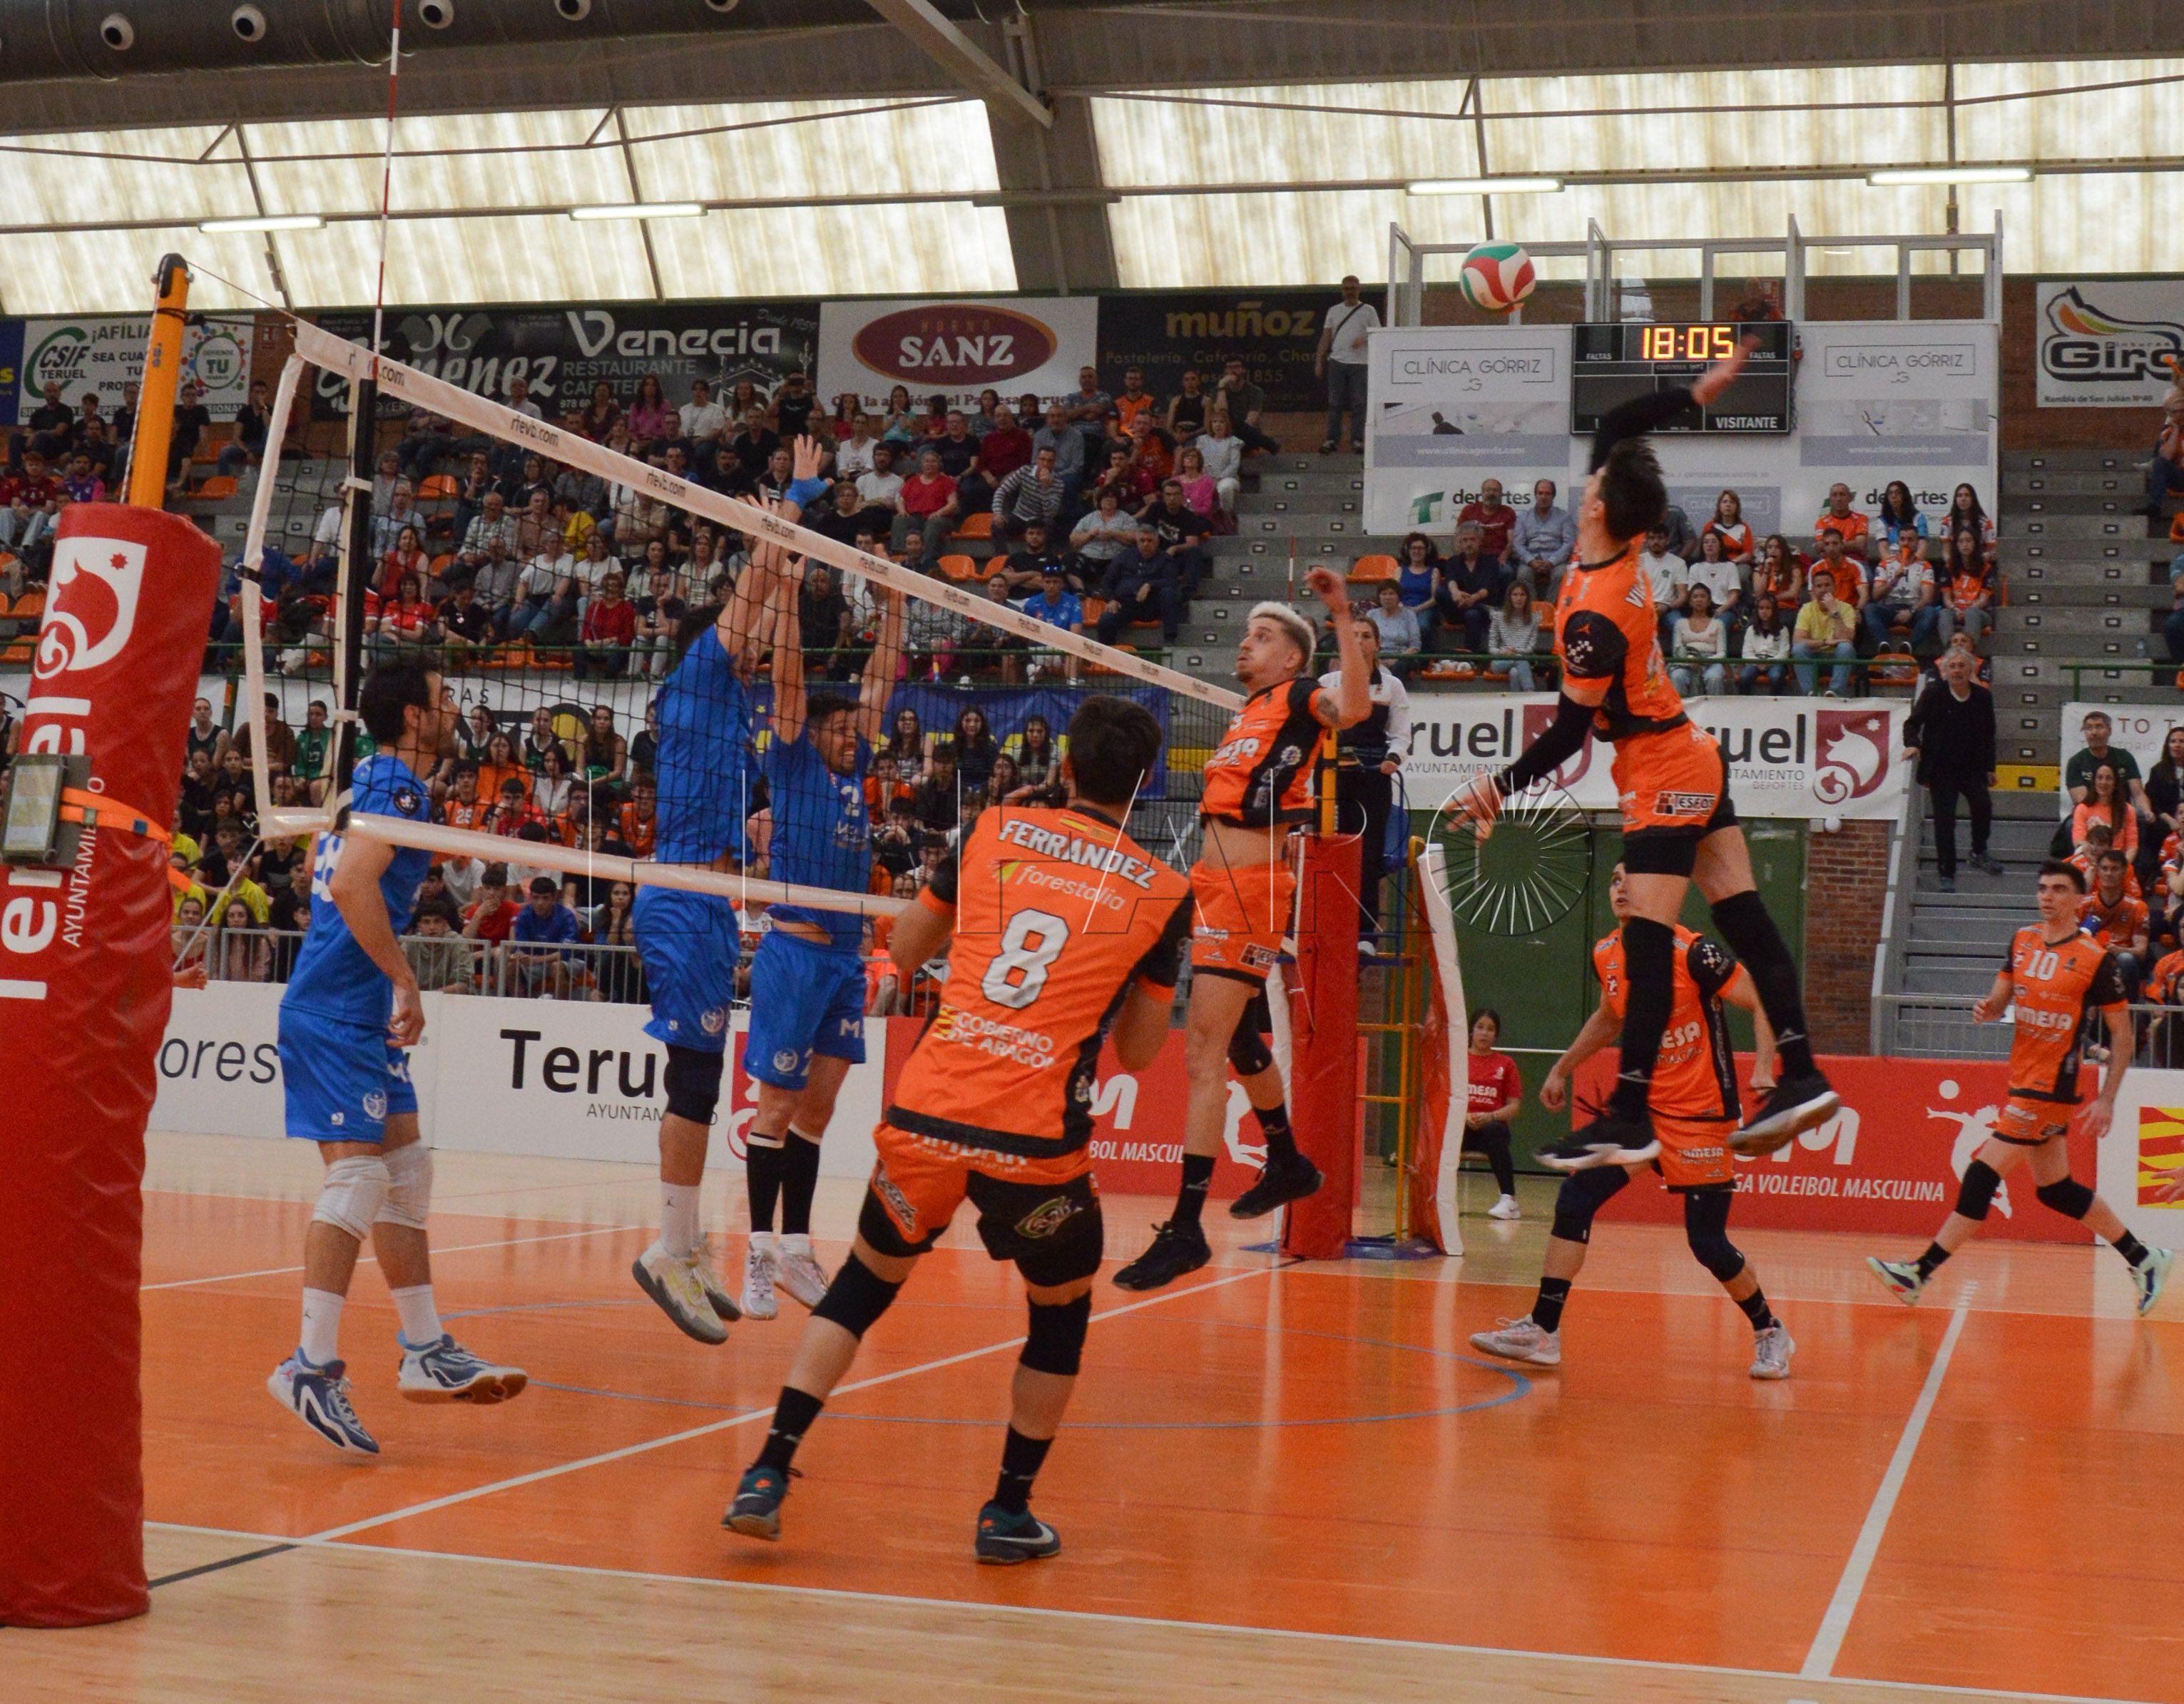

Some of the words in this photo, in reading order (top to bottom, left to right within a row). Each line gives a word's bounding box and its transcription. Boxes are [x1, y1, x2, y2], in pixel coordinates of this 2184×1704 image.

[1166, 300, 1316, 337] muñoz
[566, 310, 780, 357] Venecia
[1642, 326, 1734, 359] 18:05
[39, 345, 91, 369] CSIF
[92, 352, 116, 362] SEA
[120, 352, 148, 362] CUA
[898, 335, 1014, 367] SANZ
[1837, 353, 1899, 369] CLÍNICA
[1905, 352, 1964, 368] GÓRRIZ
[40, 369, 87, 380] TERUEL
[206, 359, 229, 374] TU
[563, 359, 697, 377] RESTAURANTE
[1404, 357, 1472, 375] CLÍNICA
[1479, 357, 1541, 374] GÓRRIZ
[1715, 417, 1778, 429] VISITANTE
[1407, 708, 1514, 758] ruel
[1016, 864, 1127, 912] forestalia
[981, 908, 1071, 1009] 8
[2023, 949, 2059, 981] 10
[500, 1029, 669, 1098] Teru
[1758, 1175, 1839, 1198] VOLEIBOL
[1842, 1178, 1945, 1202] MASCULINA
